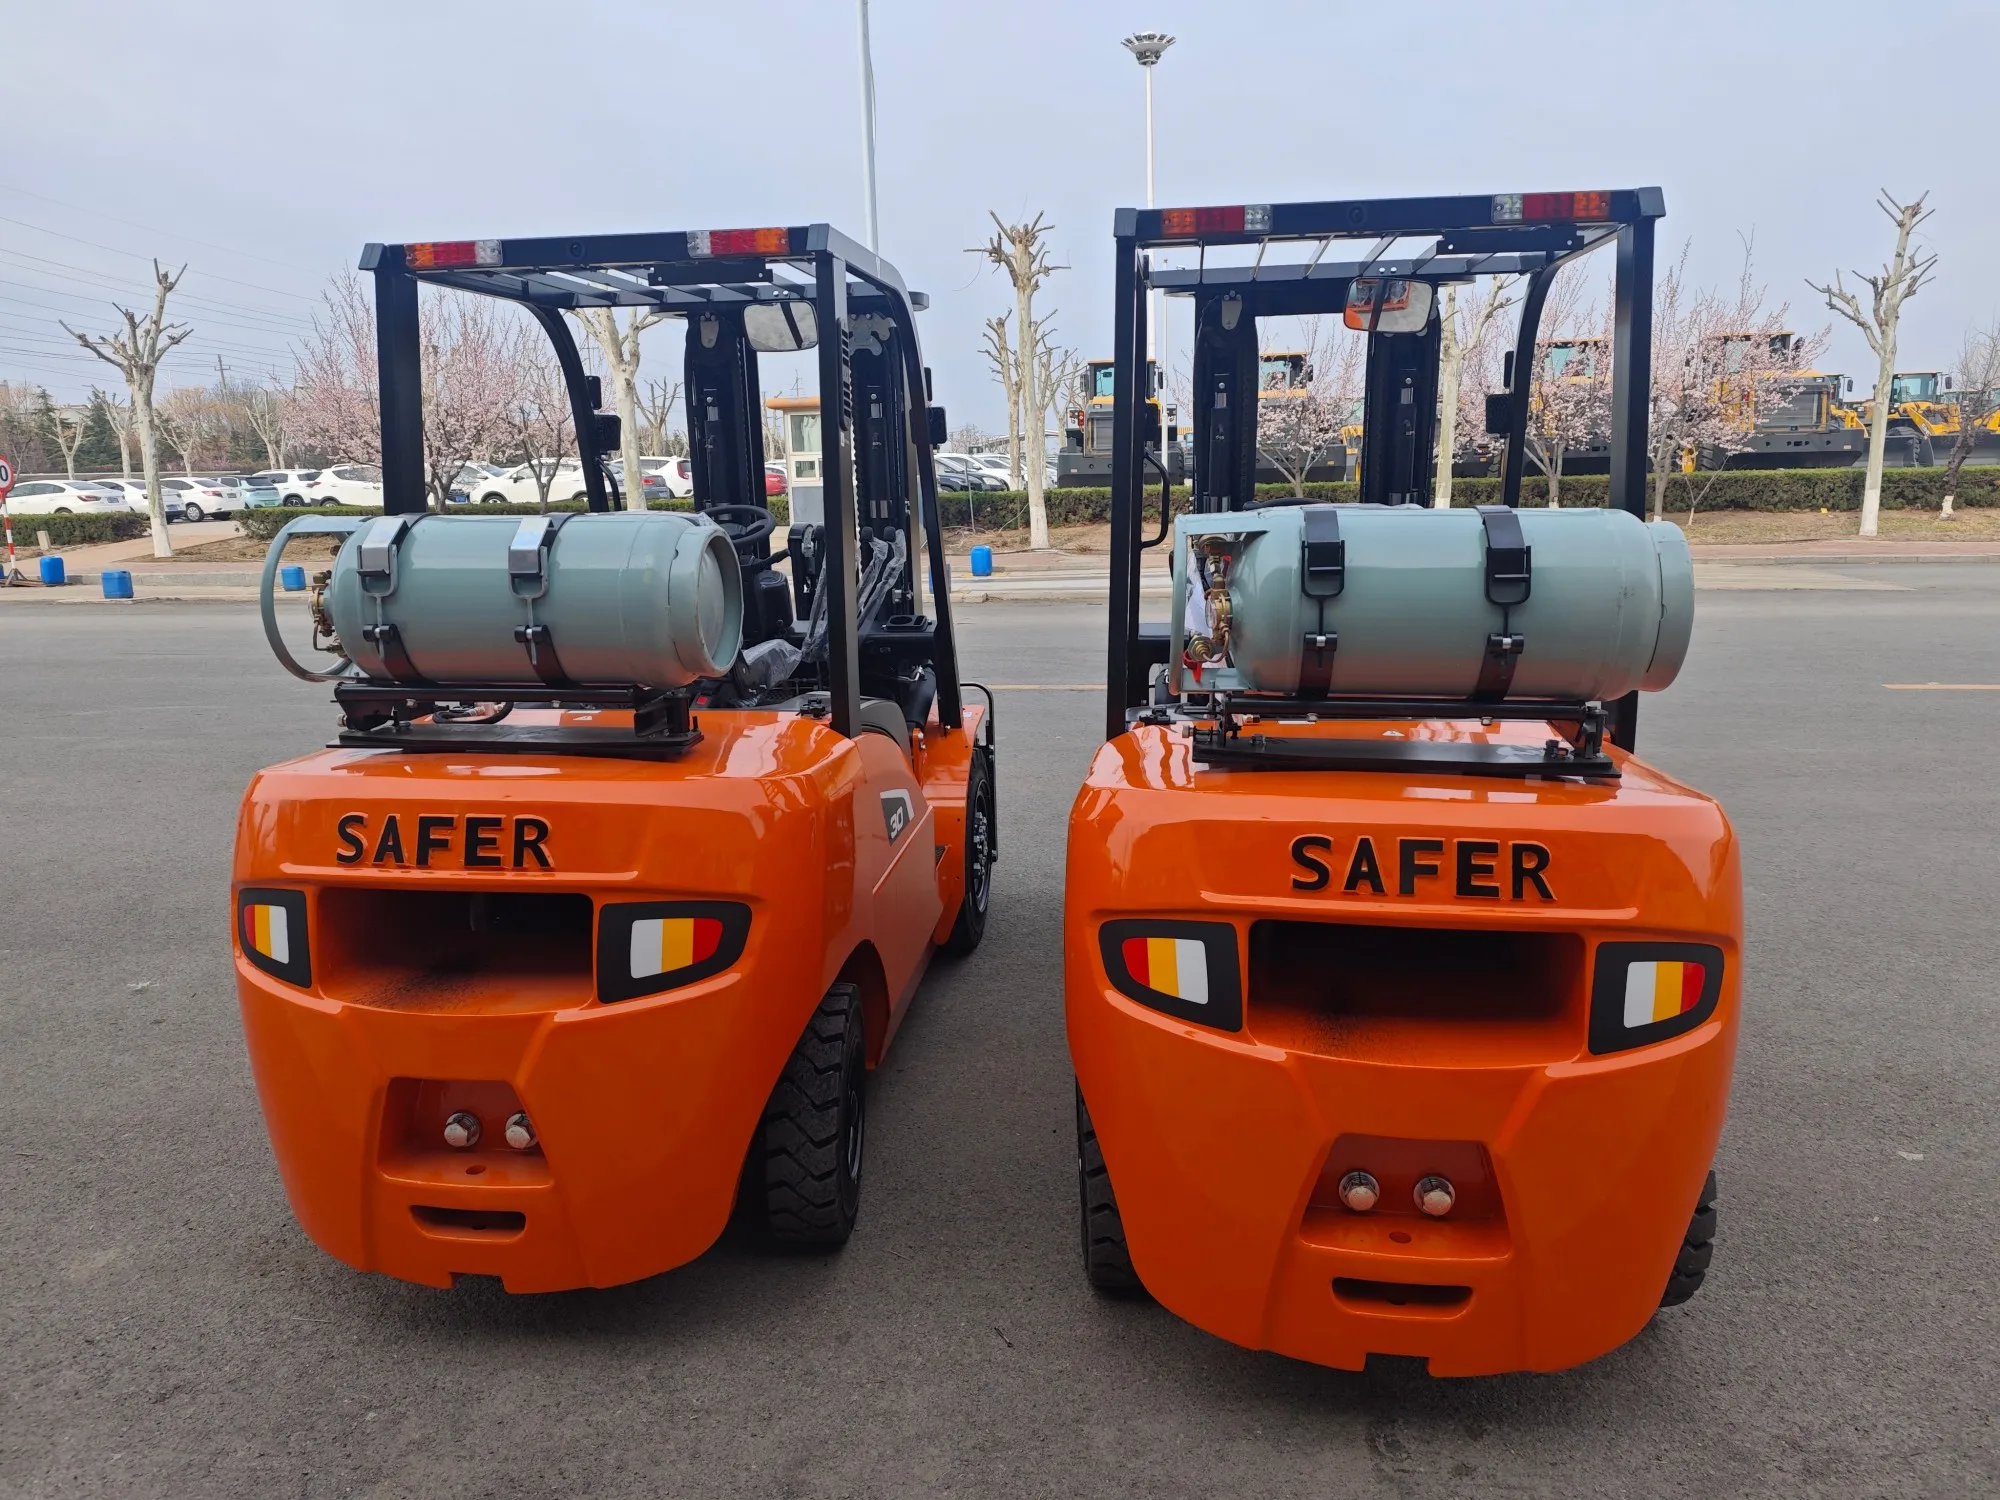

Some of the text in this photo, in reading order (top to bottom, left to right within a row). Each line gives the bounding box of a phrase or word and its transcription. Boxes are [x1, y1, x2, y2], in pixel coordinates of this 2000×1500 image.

[336, 812, 553, 869] SAFER
[889, 806, 903, 839] 30
[1289, 834, 1556, 900] SAFER
